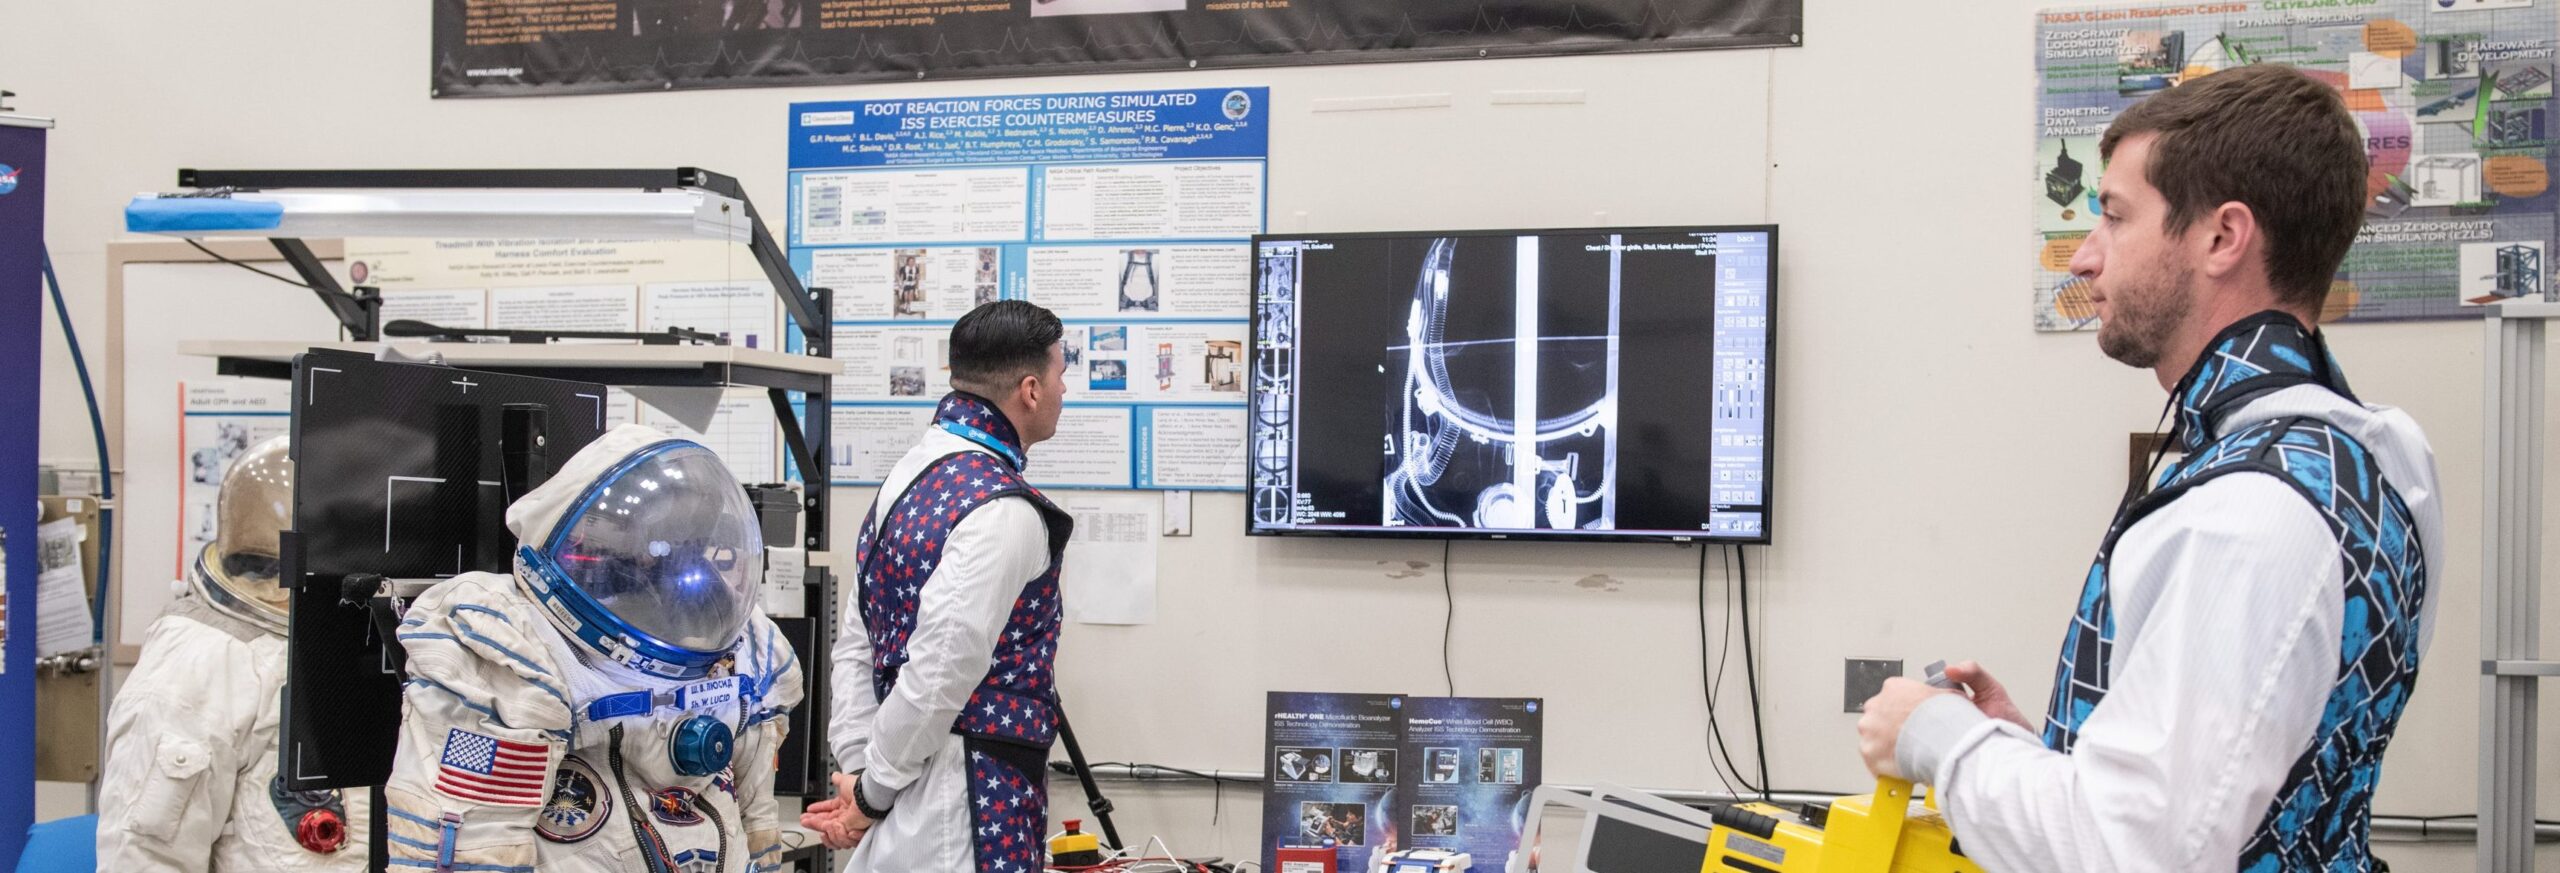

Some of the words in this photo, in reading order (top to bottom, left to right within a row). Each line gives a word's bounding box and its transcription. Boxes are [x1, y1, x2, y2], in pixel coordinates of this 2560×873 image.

[2044, 14, 2080, 24] NASA
[2084, 12, 2126, 22] GLENN
[2129, 8, 2193, 19] RESEARCH
[2197, 4, 2247, 14] CENTER
[2237, 16, 2296, 27] DYNAMIC
[2046, 28, 2130, 40] ZERO-GRAVITY
[2045, 38, 2124, 50] LOCOMOTION
[2468, 39, 2543, 51] HARDWARE
[2045, 48, 2112, 60] SIMULATOR
[2457, 49, 2554, 62] DEVELOPMENT
[864, 103, 902, 116] FOOT
[907, 101, 980, 115] REACTION
[985, 98, 1042, 112] FORCES
[1047, 96, 1106, 110] DURING
[1111, 94, 1196, 108] SIMULATED
[2045, 106, 2109, 118] BIOMETRIC
[901, 117, 925, 130] ISS
[930, 115, 1000, 129] EXERCISE
[1005, 110, 1156, 127] COUNTERMEASURES
[2045, 118, 2077, 127] DATA
[2045, 126, 2102, 136] ANALYSIS
[2358, 222, 2401, 233] ANCED
[2404, 221, 2493, 232] ZERO-GRAVITY
[2375, 232, 2446, 242] SIMULATOR
[495, 250, 530, 258] Harness
[533, 249, 568, 258] Comfort
[571, 248, 616, 256] Evaluation
[706, 678, 733, 691] ЛЮСИД
[691, 700, 699, 709] Sh.
[702, 698, 709, 706] W.
[710, 694, 731, 705] LUCID
[1286, 720, 1318, 728] Technology
[1358, 714, 1391, 722] Bioanalyzer
[1408, 726, 1432, 734] Analyzer
[1446, 726, 1478, 734] Technology
